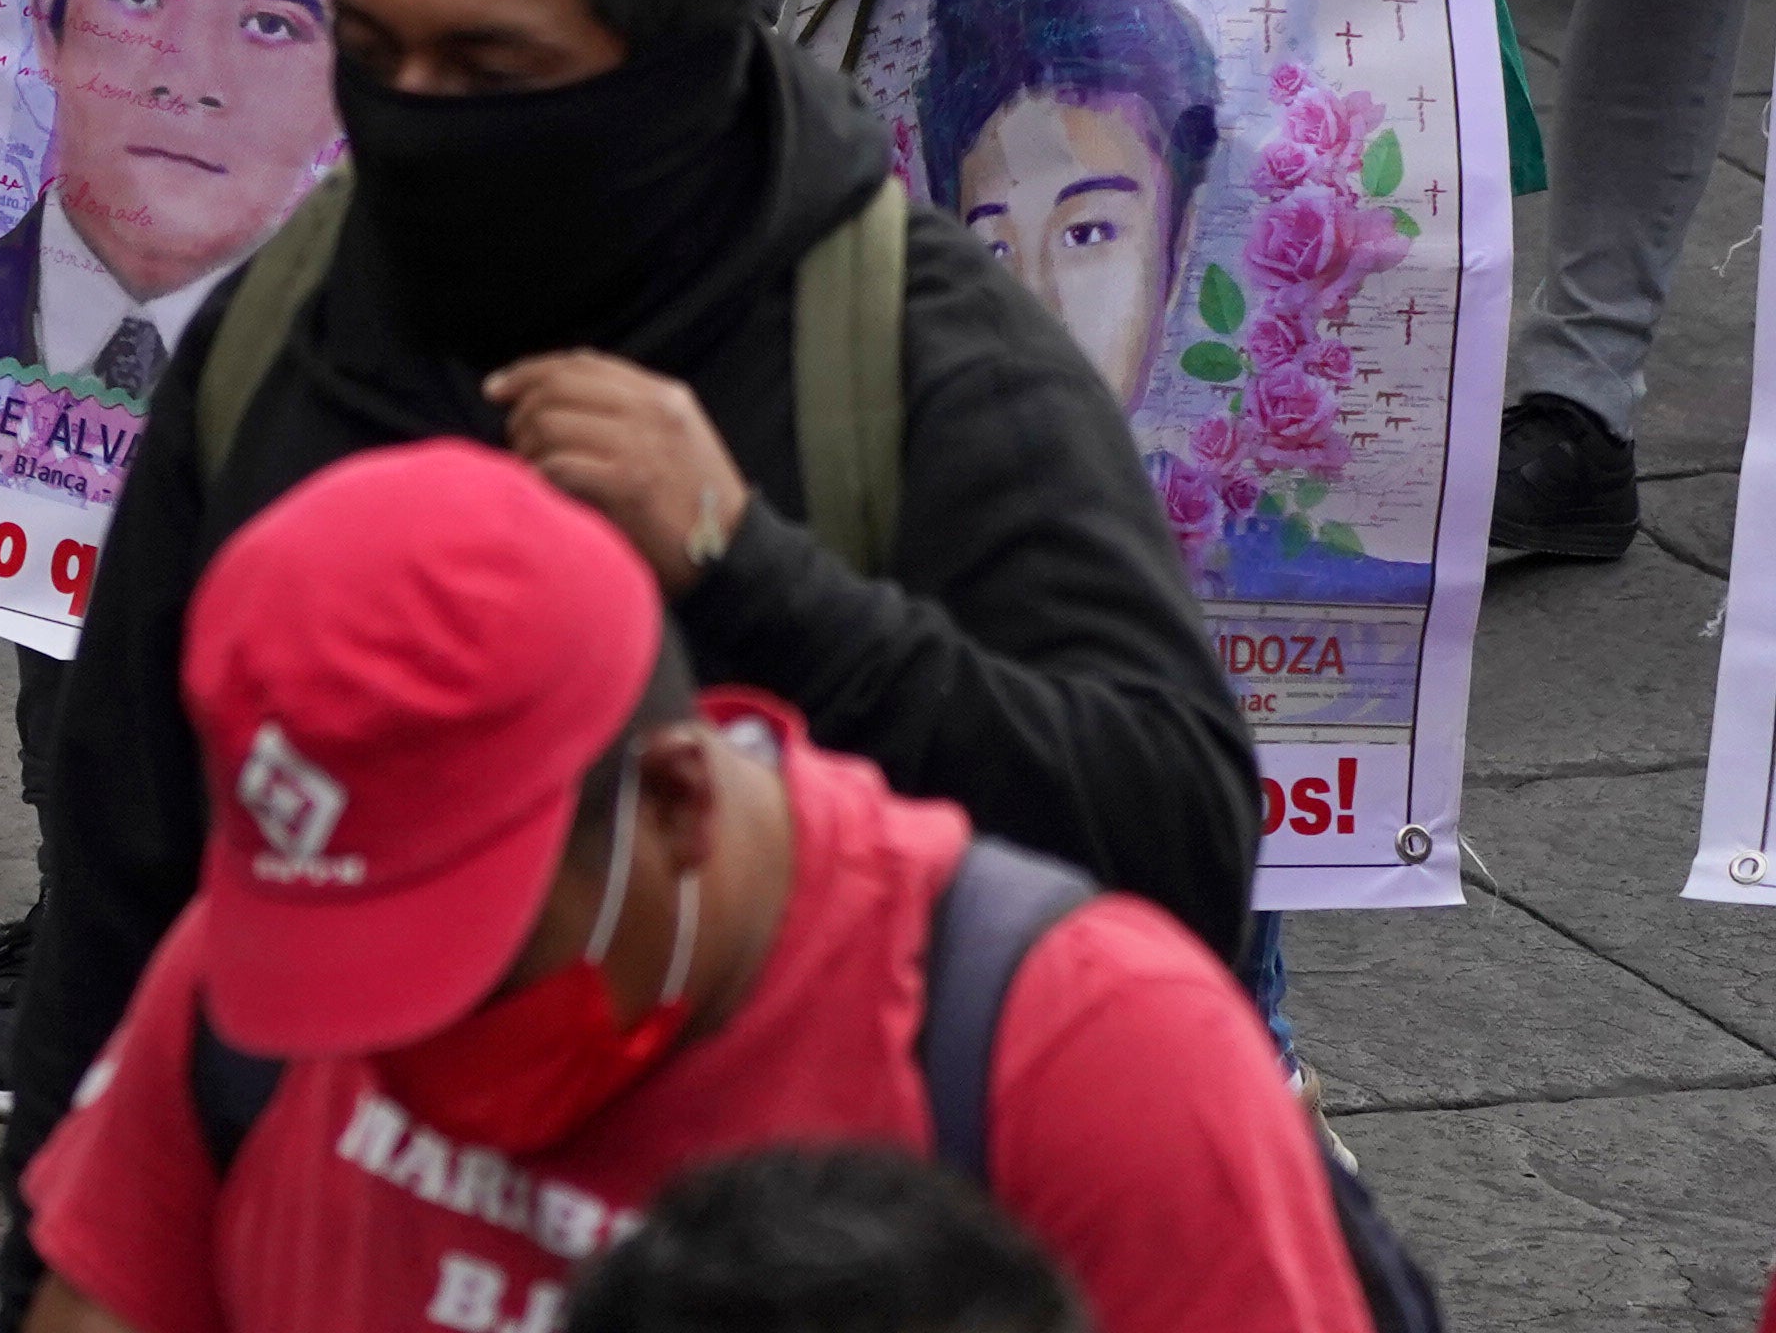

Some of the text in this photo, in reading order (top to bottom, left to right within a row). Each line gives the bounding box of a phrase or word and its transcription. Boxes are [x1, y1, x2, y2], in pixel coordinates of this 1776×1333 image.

[13, 454, 90, 494] Blanca
[50, 537, 99, 618] q
[1258, 756, 1358, 837] os!
